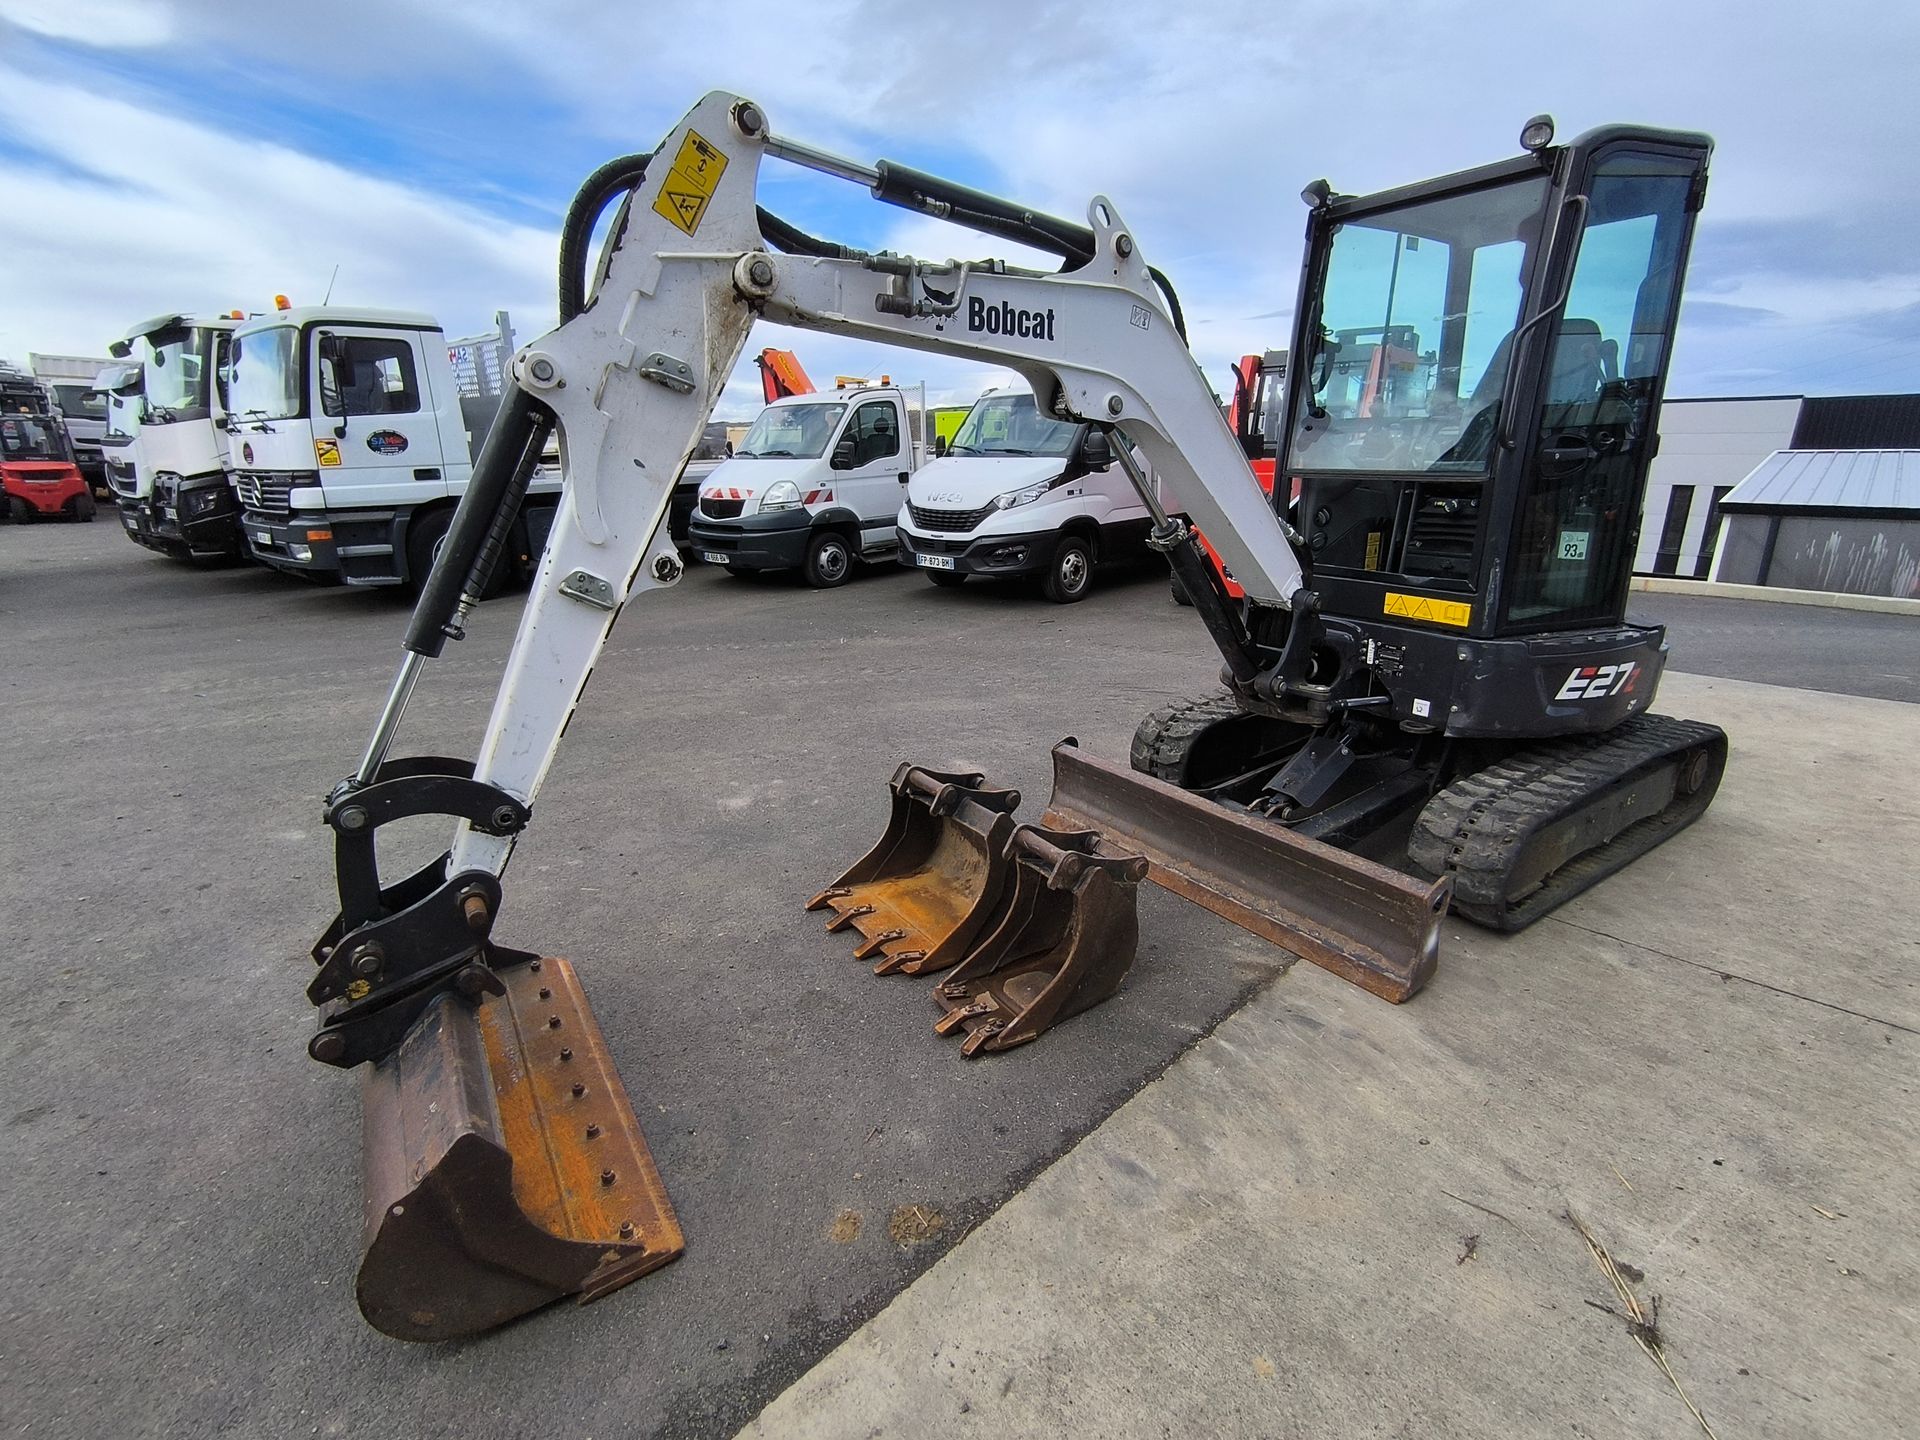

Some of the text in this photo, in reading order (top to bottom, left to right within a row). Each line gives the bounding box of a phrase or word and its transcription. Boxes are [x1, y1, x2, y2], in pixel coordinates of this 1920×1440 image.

[968, 296, 1055, 341] Bobcat
[928, 491, 964, 503] IVECO
[1564, 544, 1578, 557] 93
